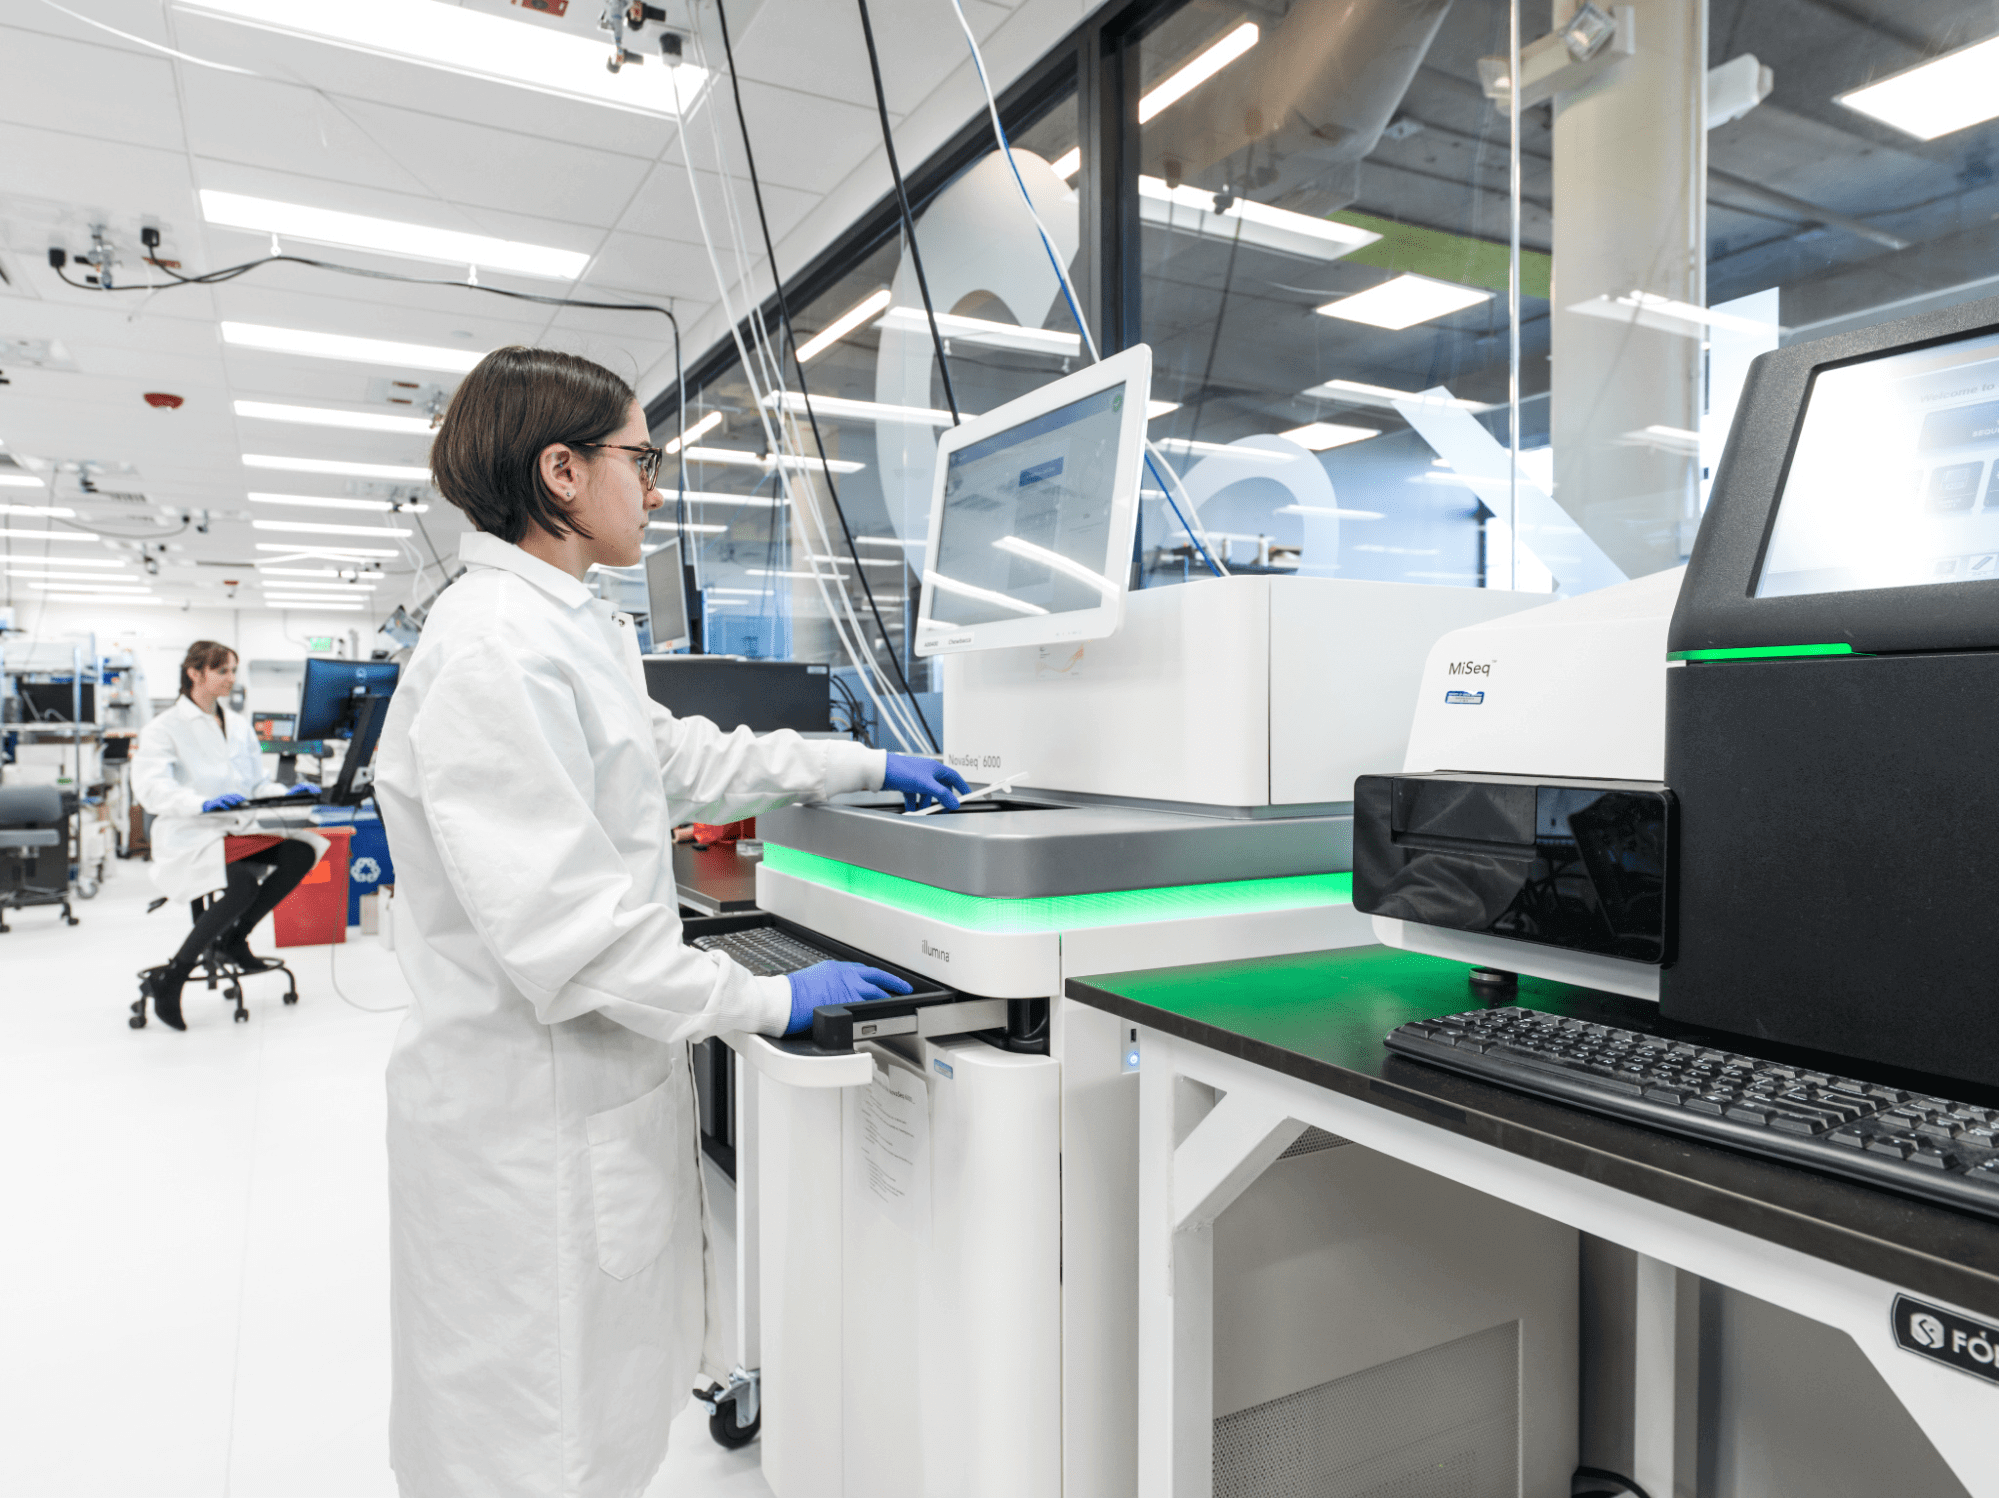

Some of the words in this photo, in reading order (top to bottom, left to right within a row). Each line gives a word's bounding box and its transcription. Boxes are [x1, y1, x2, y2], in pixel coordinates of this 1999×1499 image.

[1921, 387, 1978, 403] Welcome
[1982, 383, 1995, 392] to
[983, 755, 1001, 768] 6000
[921, 939, 950, 963] illumina
